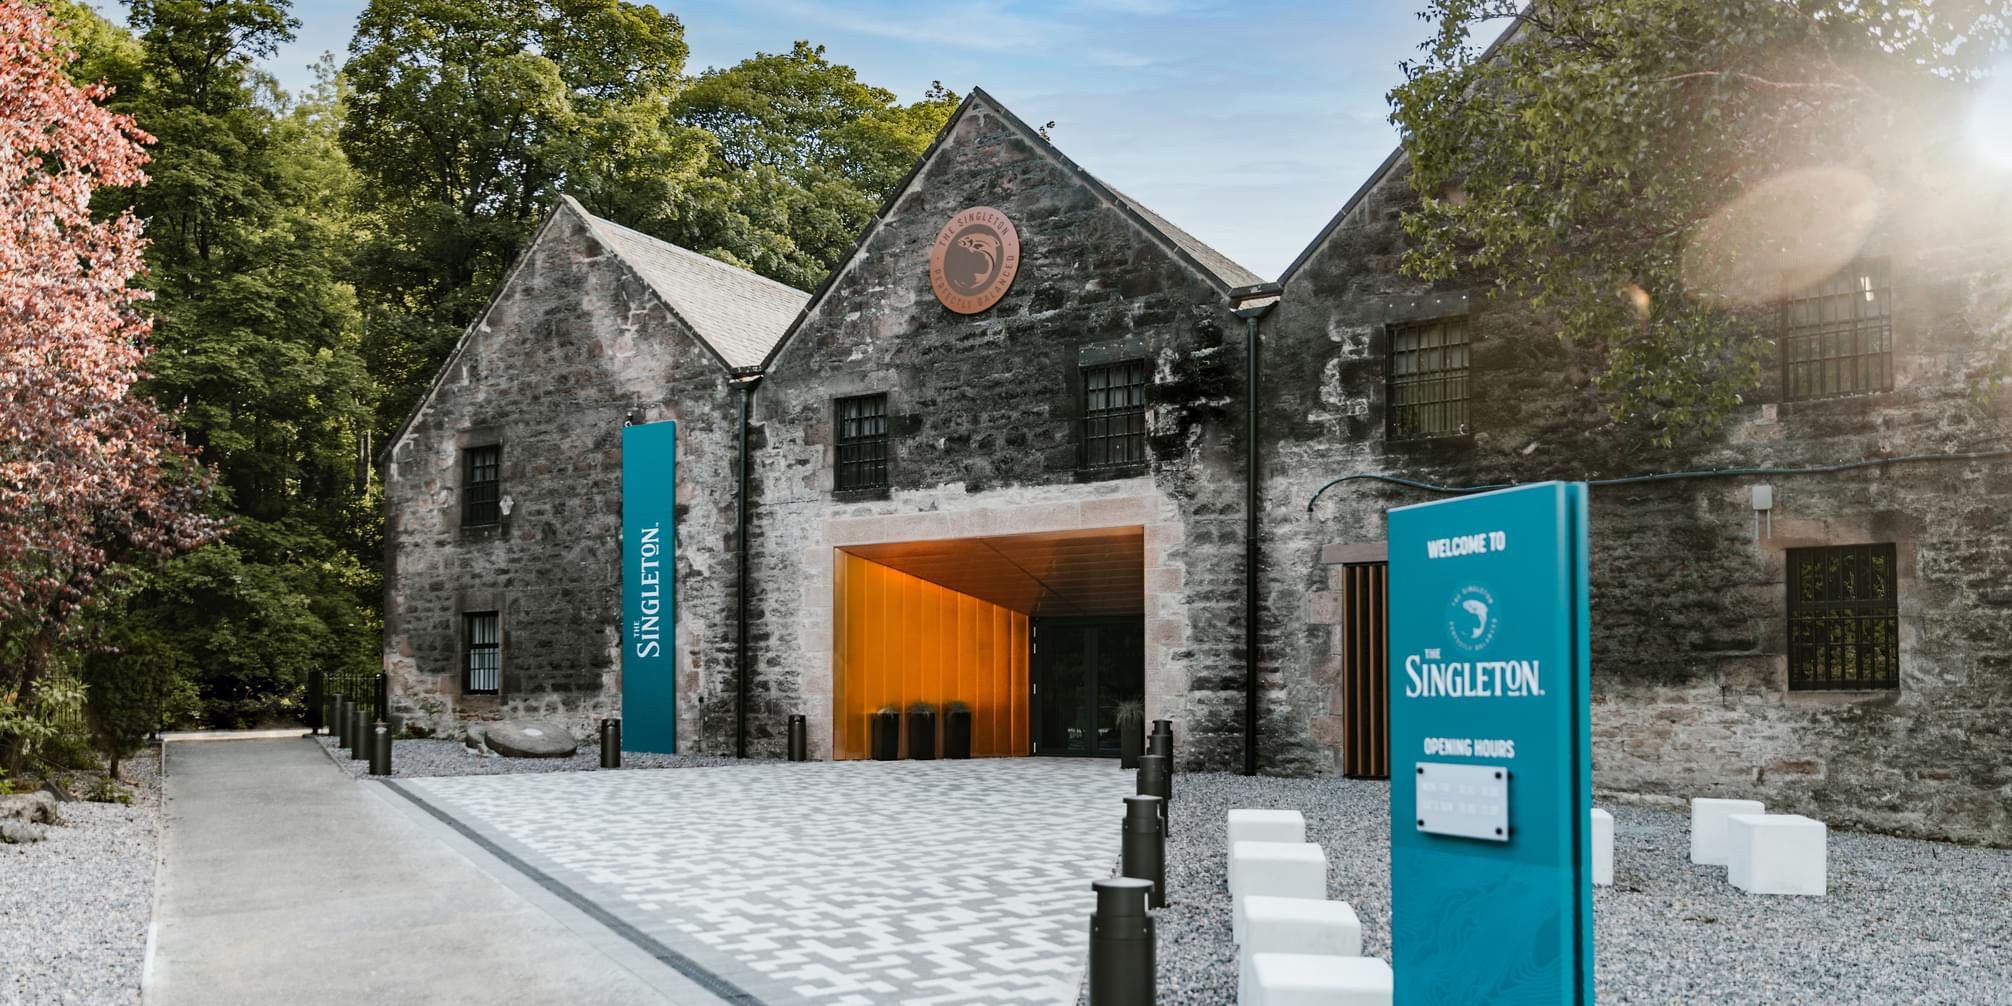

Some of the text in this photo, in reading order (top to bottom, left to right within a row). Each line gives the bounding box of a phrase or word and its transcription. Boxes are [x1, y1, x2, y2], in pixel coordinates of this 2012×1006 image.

[939, 211, 1009, 247] THE SINGLETON
[976, 255, 1015, 307] BALANCED
[1427, 531, 1506, 559] WELCOME TO
[633, 621, 641, 638] THE
[1424, 648, 1440, 659] THE
[1424, 737, 1515, 758] OPENING HOURS
